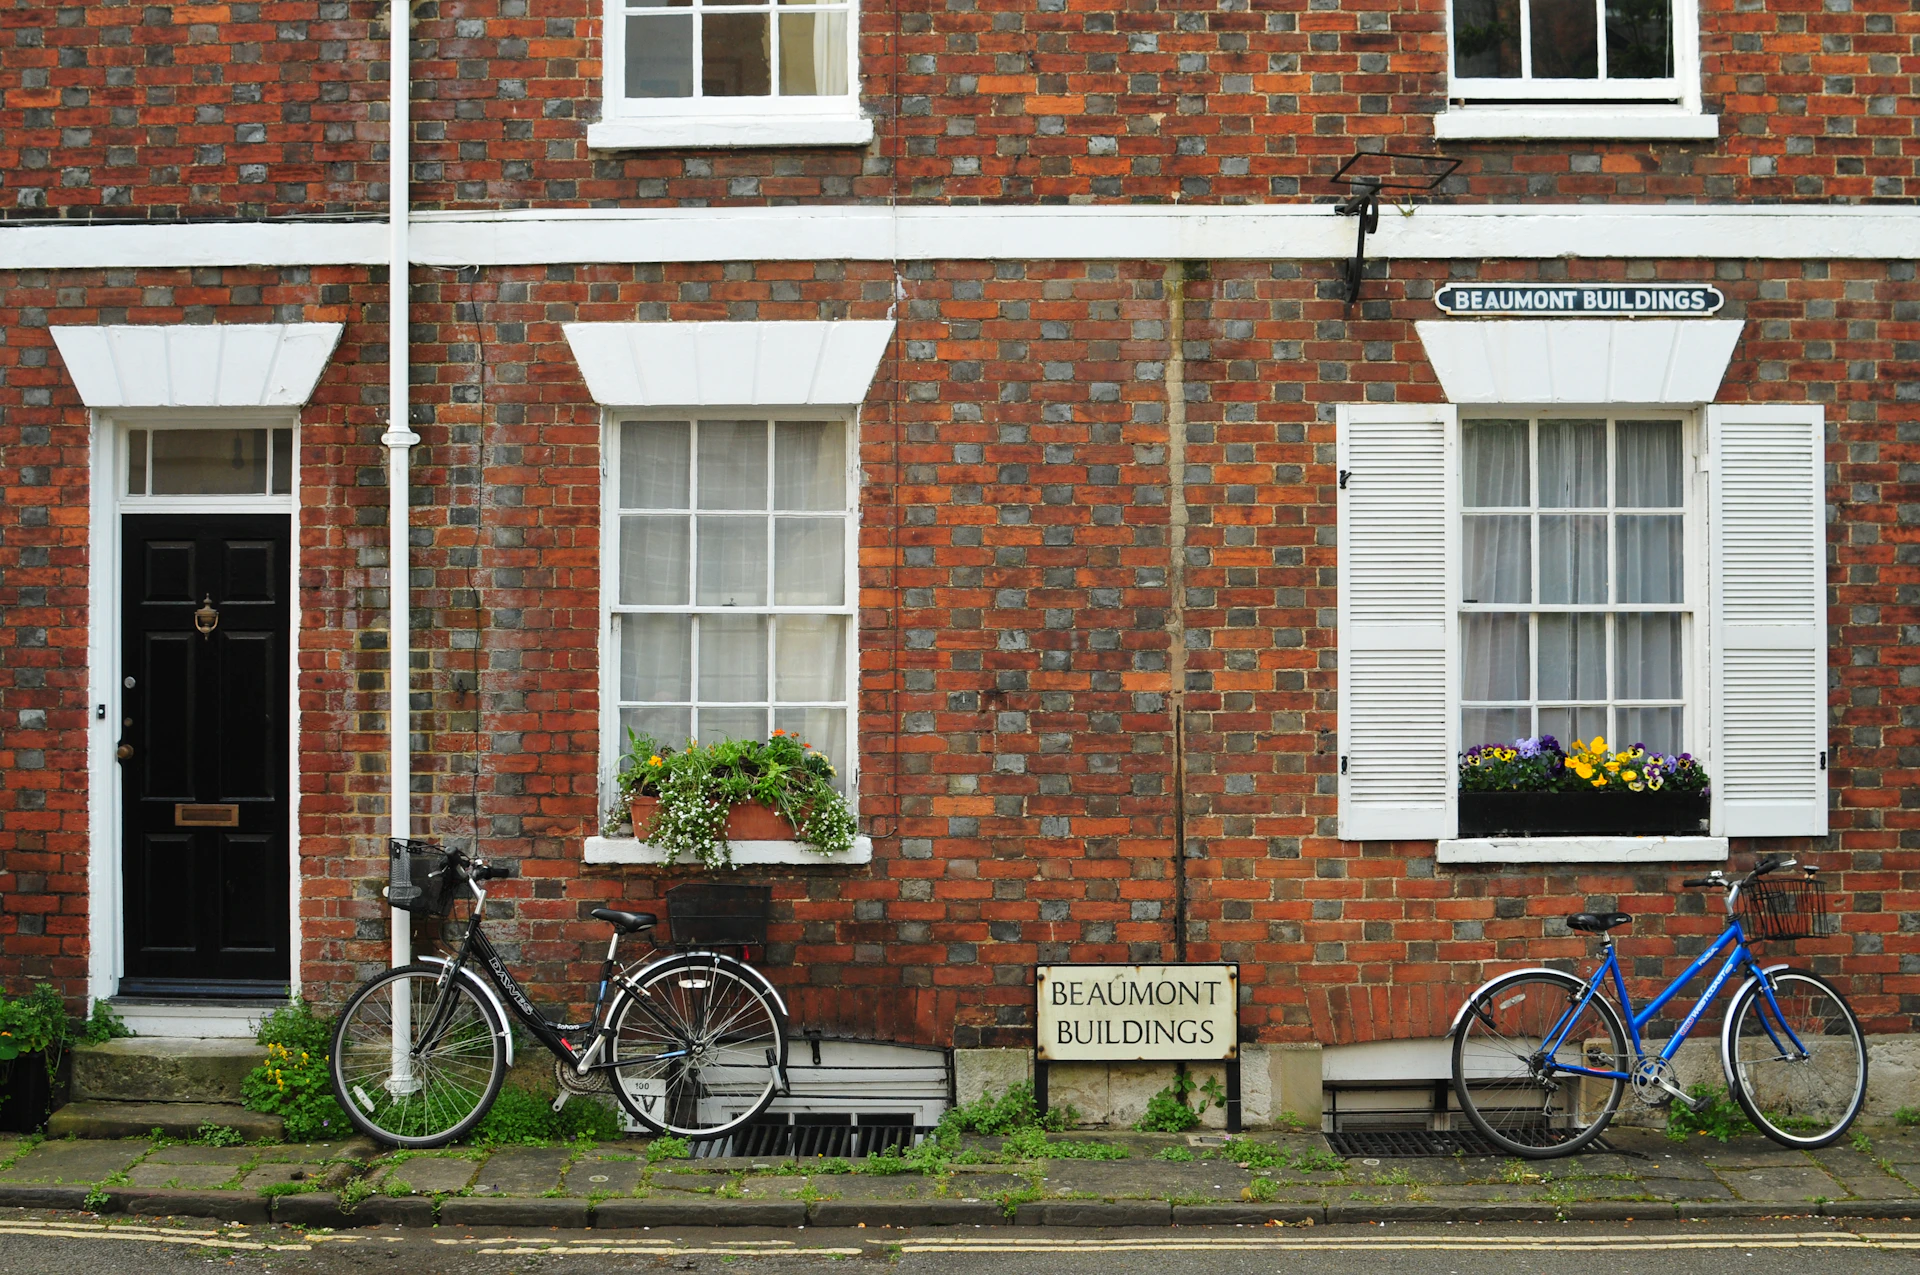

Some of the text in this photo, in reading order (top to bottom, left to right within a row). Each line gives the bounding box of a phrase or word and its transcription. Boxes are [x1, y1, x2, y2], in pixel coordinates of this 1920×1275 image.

[1455, 290, 1706, 310] BEAUMONT BUILDINGS
[489, 957, 534, 1016] DAWES
[1051, 981, 1222, 1006] BEAUMONT
[1057, 1019, 1214, 1045] BUILDINGS
[635, 1082, 650, 1090] 100
